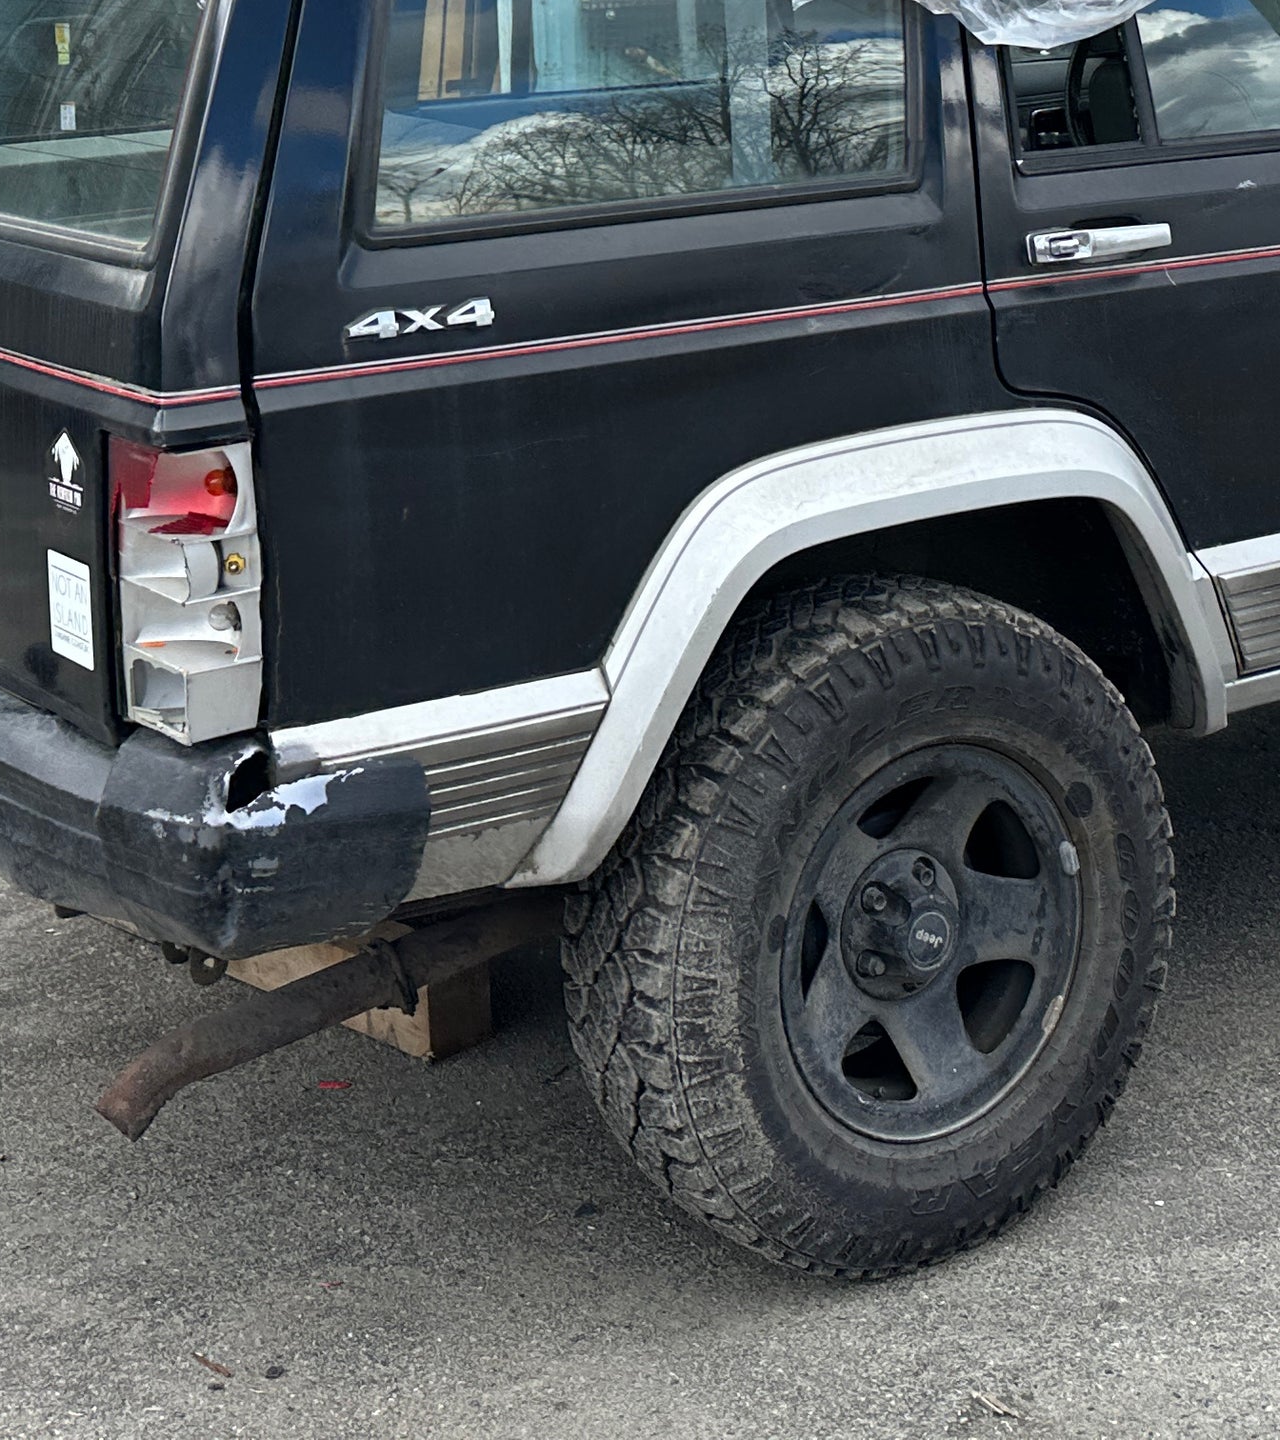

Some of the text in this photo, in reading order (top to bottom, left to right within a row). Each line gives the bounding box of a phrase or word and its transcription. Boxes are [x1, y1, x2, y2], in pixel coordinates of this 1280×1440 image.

[51, 570, 87, 606] NOT AN
[53, 601, 89, 636] ISLAND
[915, 928, 943, 949] Jeep
